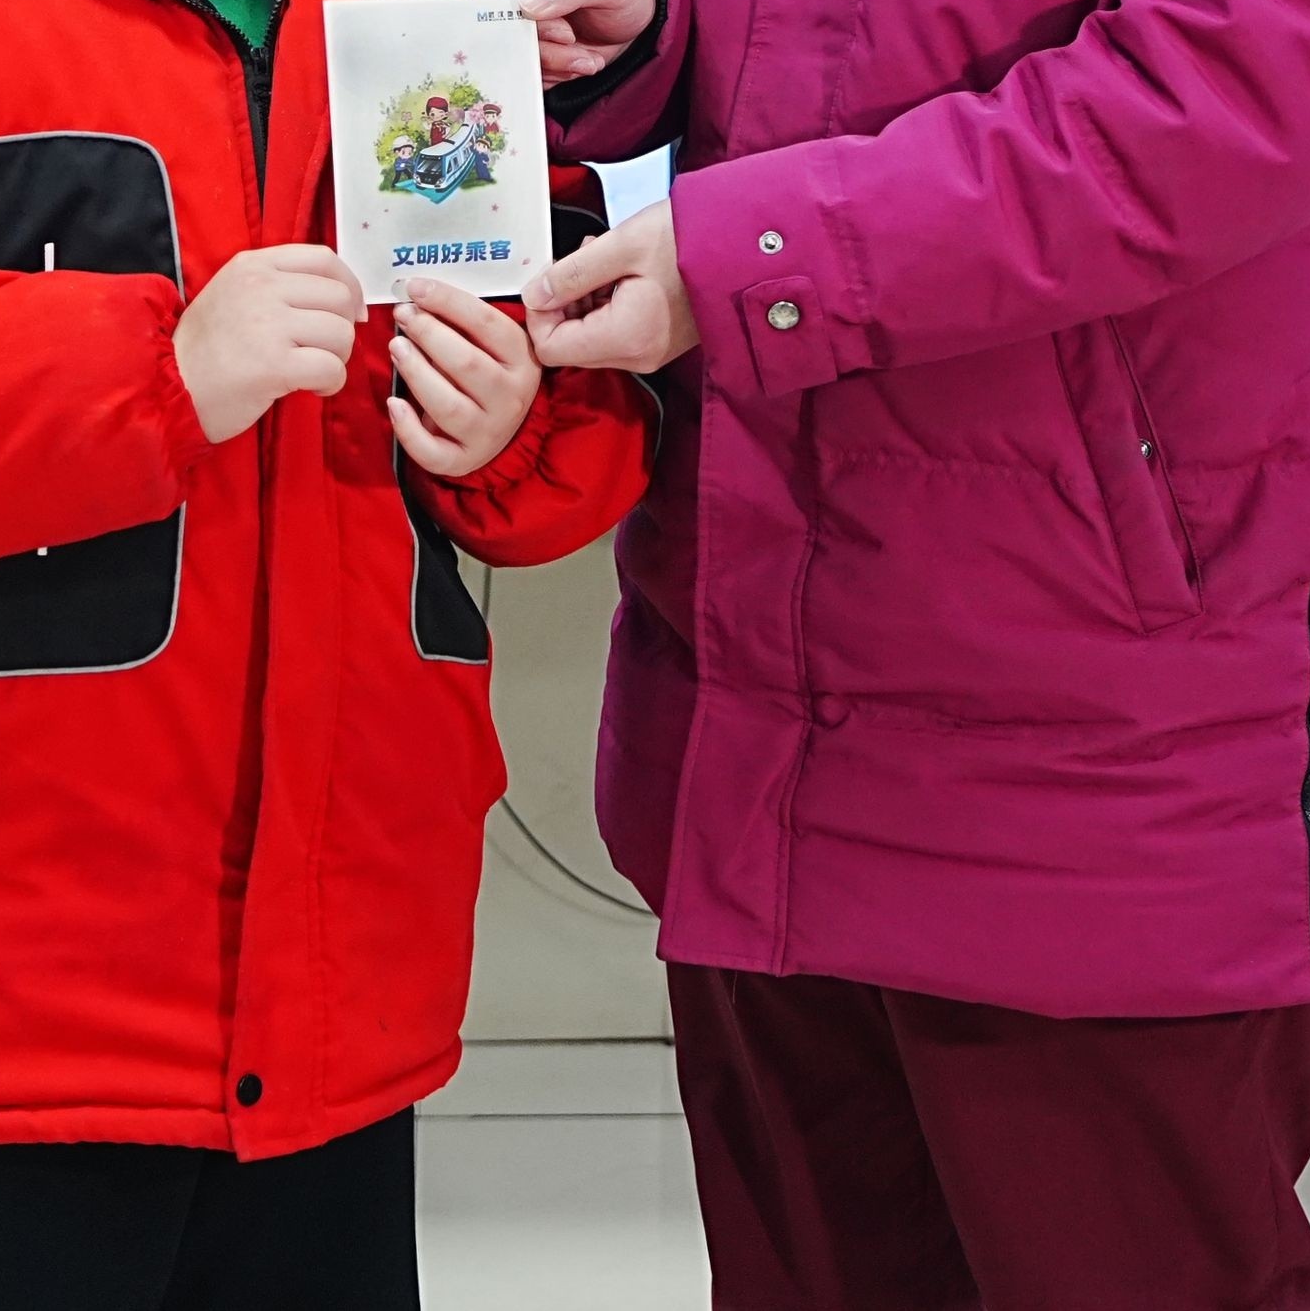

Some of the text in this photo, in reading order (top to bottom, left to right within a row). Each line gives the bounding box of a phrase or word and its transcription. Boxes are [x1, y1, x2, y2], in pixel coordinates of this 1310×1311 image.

[392, 240, 511, 267] 文明好乘客
